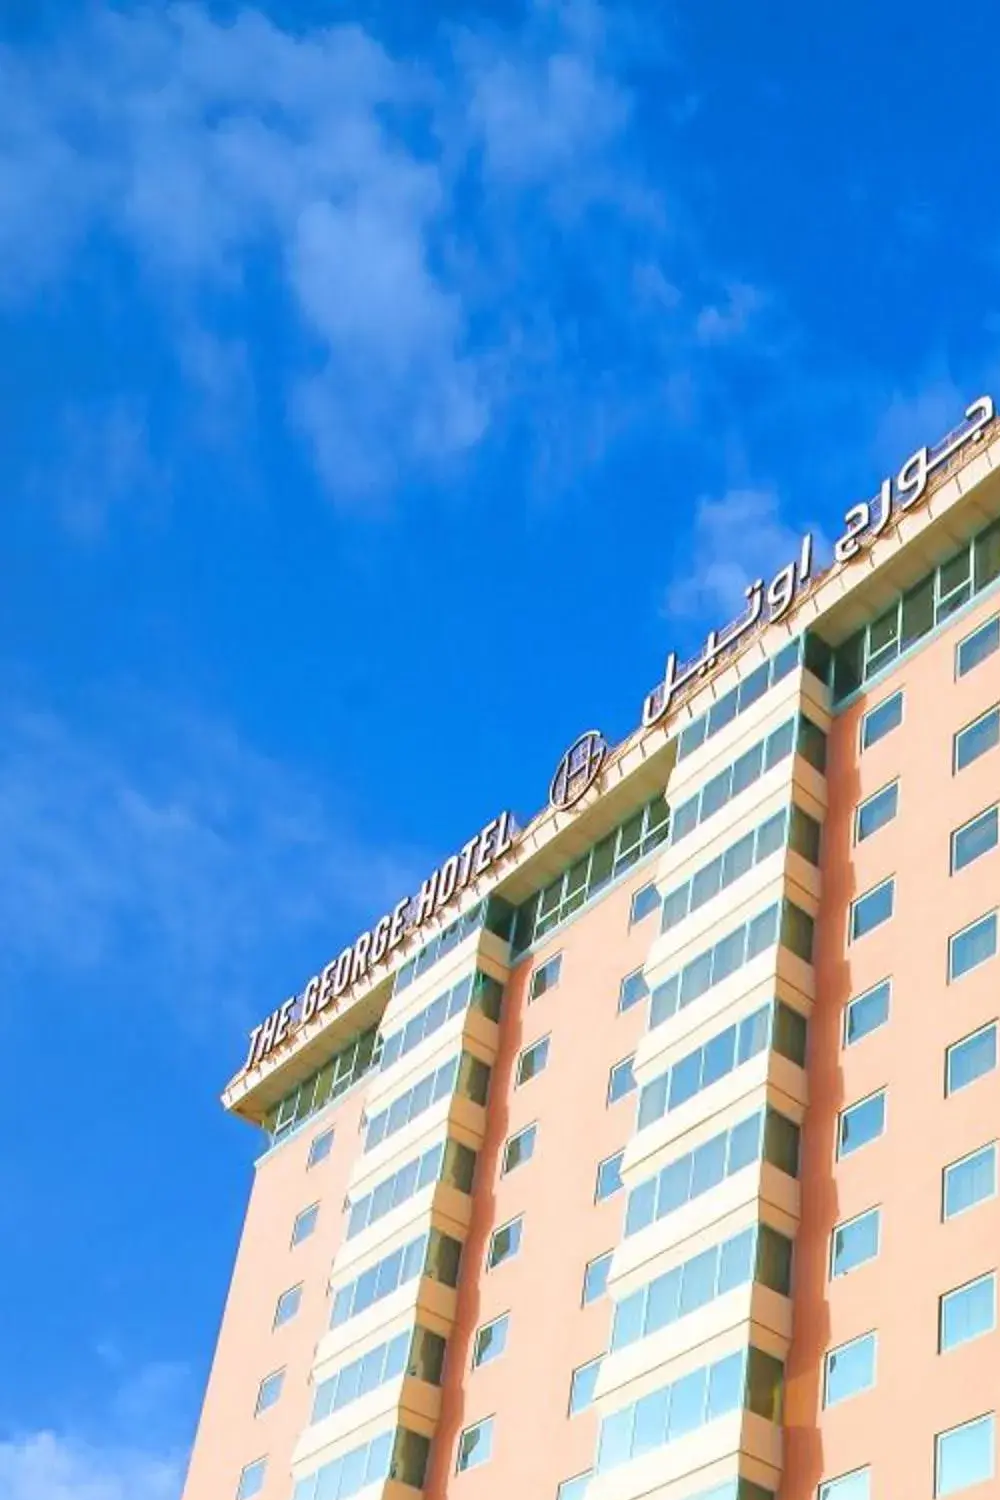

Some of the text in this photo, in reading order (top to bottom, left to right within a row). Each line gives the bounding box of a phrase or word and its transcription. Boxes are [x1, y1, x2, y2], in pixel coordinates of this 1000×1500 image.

[834, 394, 996, 561] جورج
[245, 810, 512, 1072] THE GEORGE HOTEL
